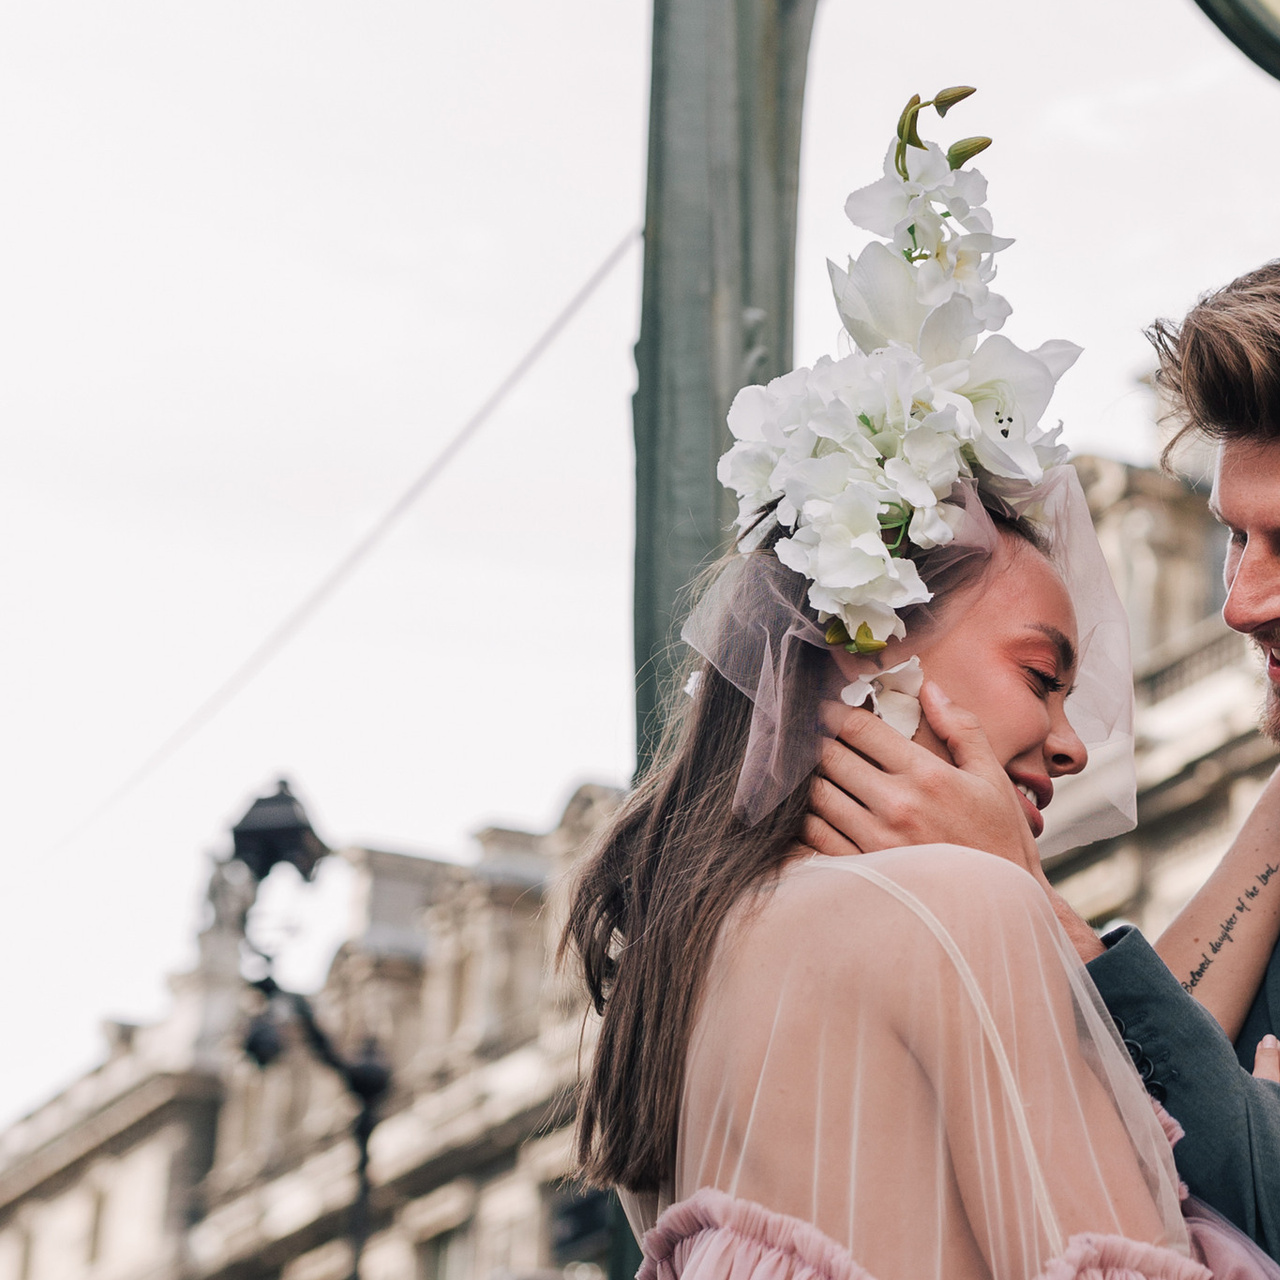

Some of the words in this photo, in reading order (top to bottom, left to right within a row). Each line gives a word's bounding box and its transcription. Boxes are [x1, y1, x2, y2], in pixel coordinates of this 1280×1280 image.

[1208, 913, 1238, 954] daughter
[1235, 897, 1251, 913] of
[1244, 886, 1260, 900] the
